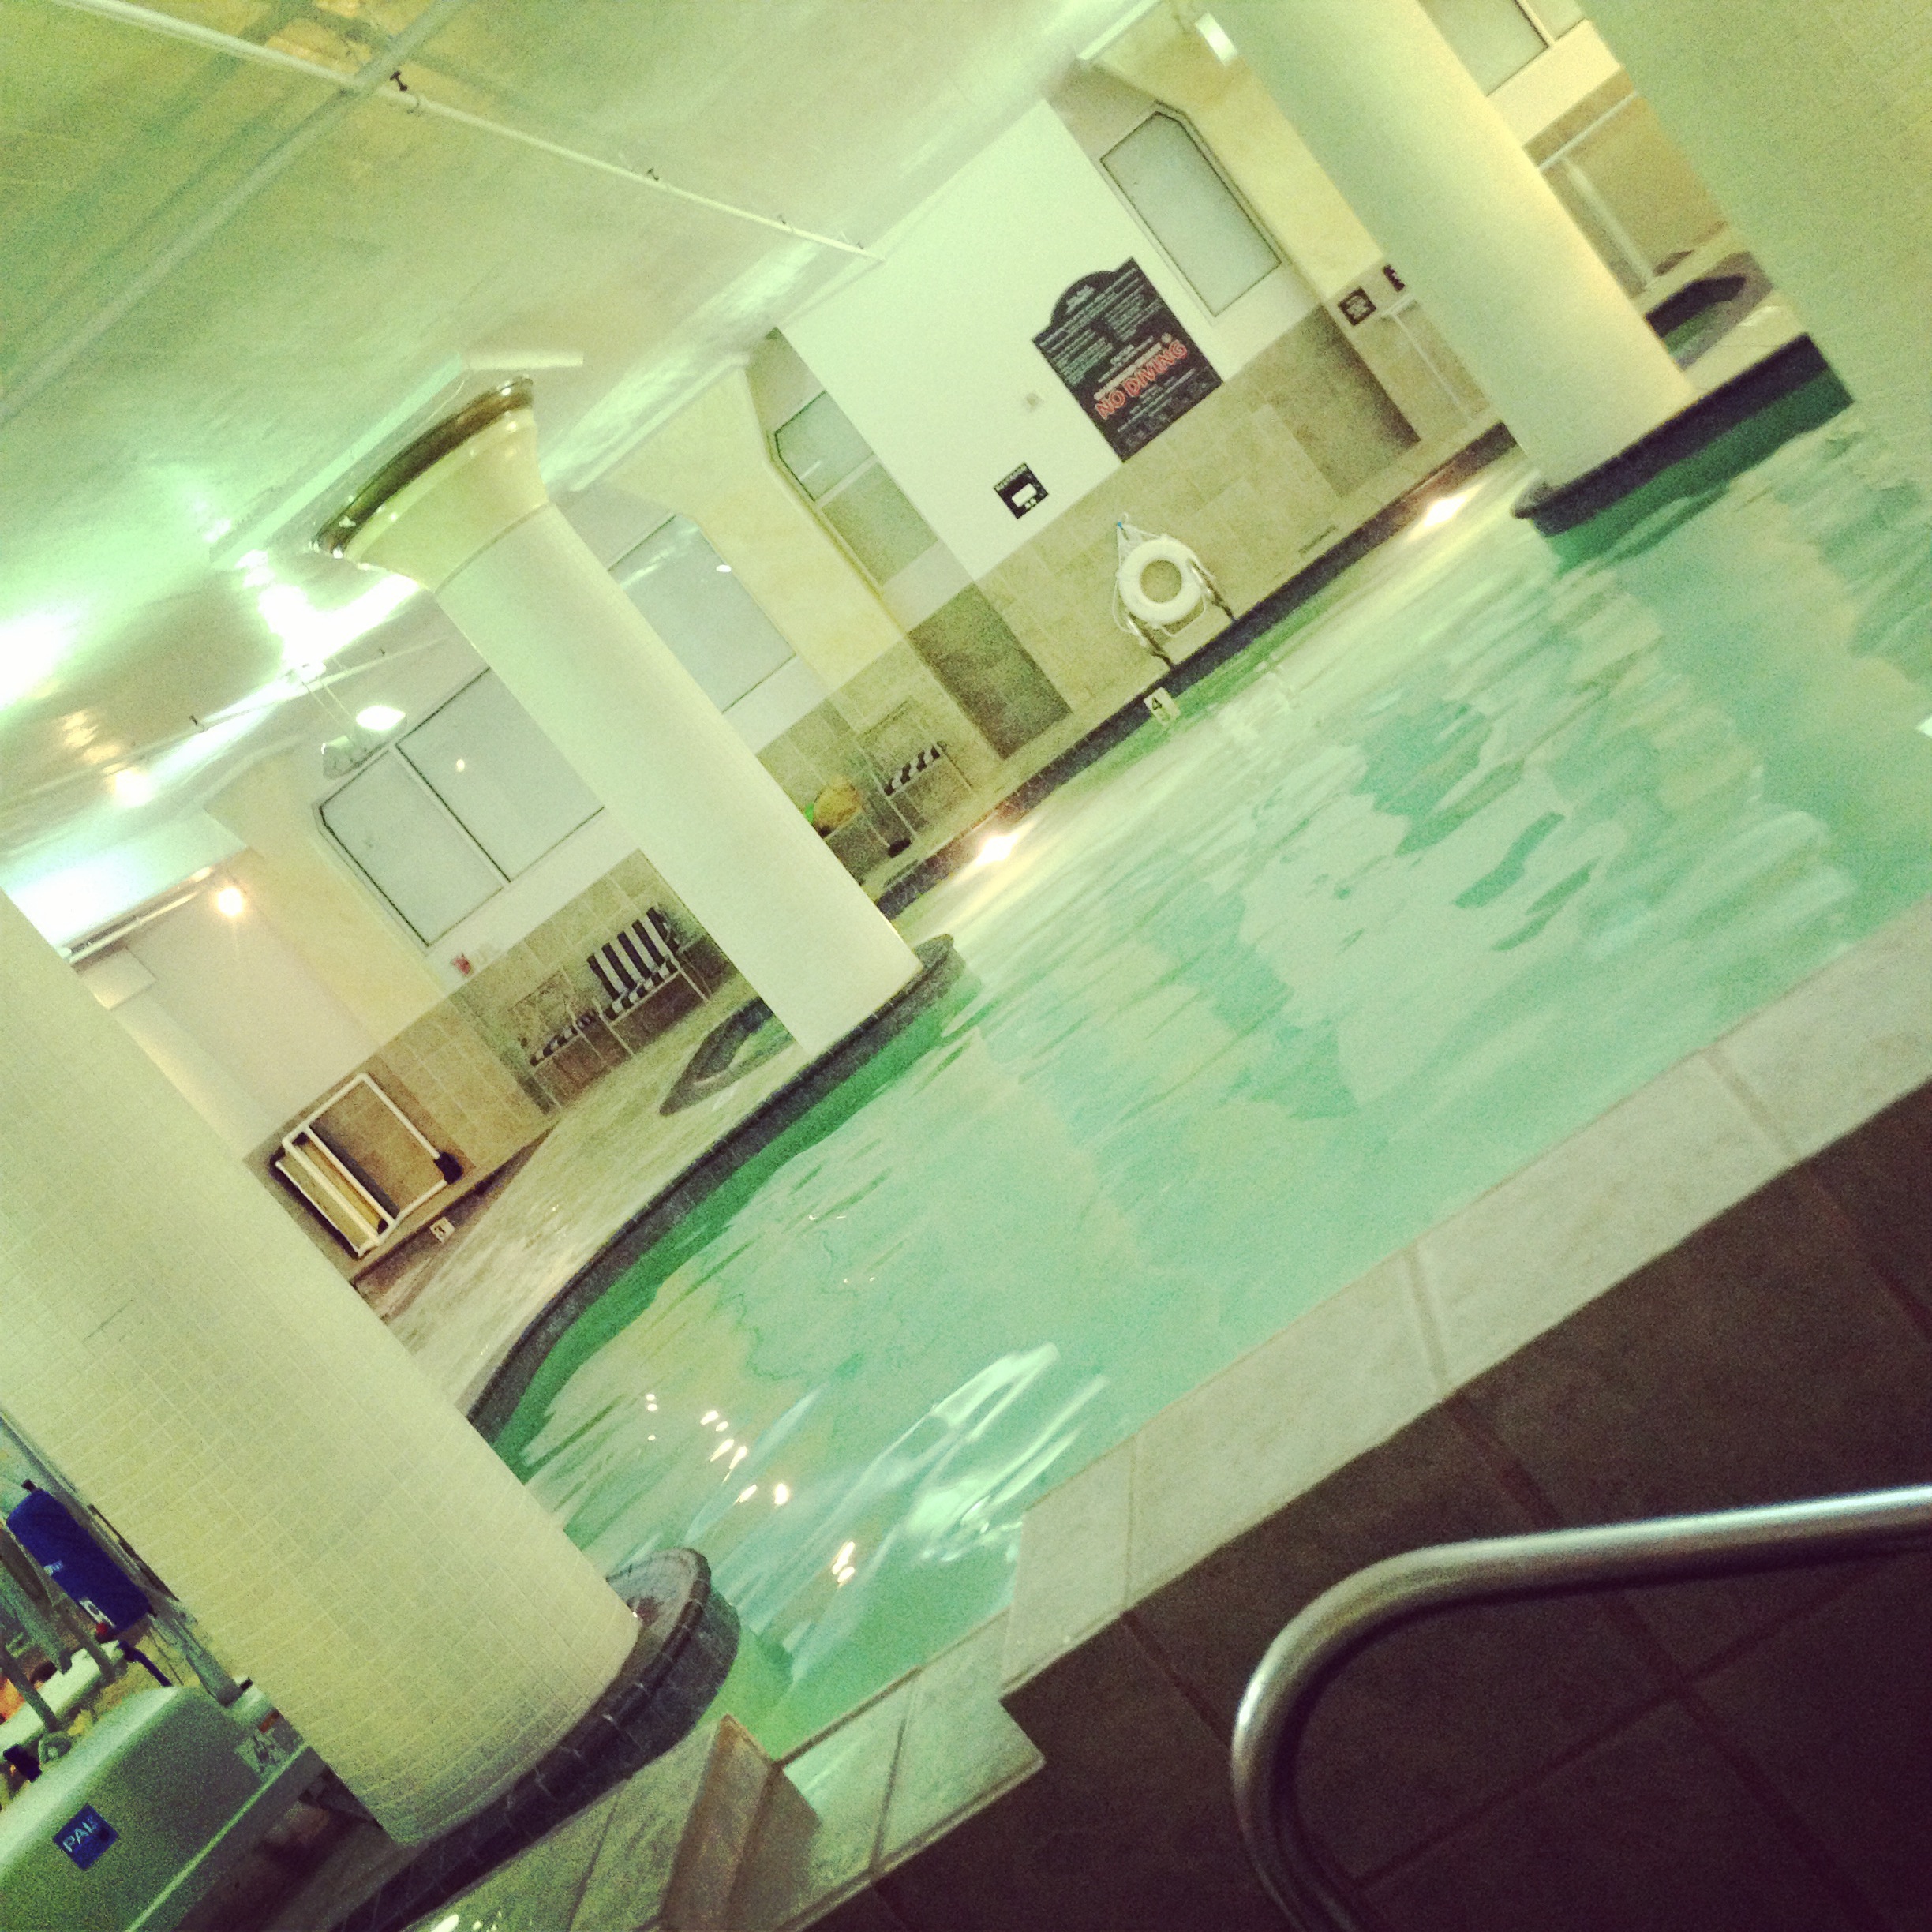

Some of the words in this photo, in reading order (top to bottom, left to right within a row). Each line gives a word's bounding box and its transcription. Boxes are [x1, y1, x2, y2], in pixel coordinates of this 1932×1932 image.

[1095, 390, 1126, 420] NO
[1124, 339, 1189, 398] DIVING
[1152, 697, 1163, 710] 4
